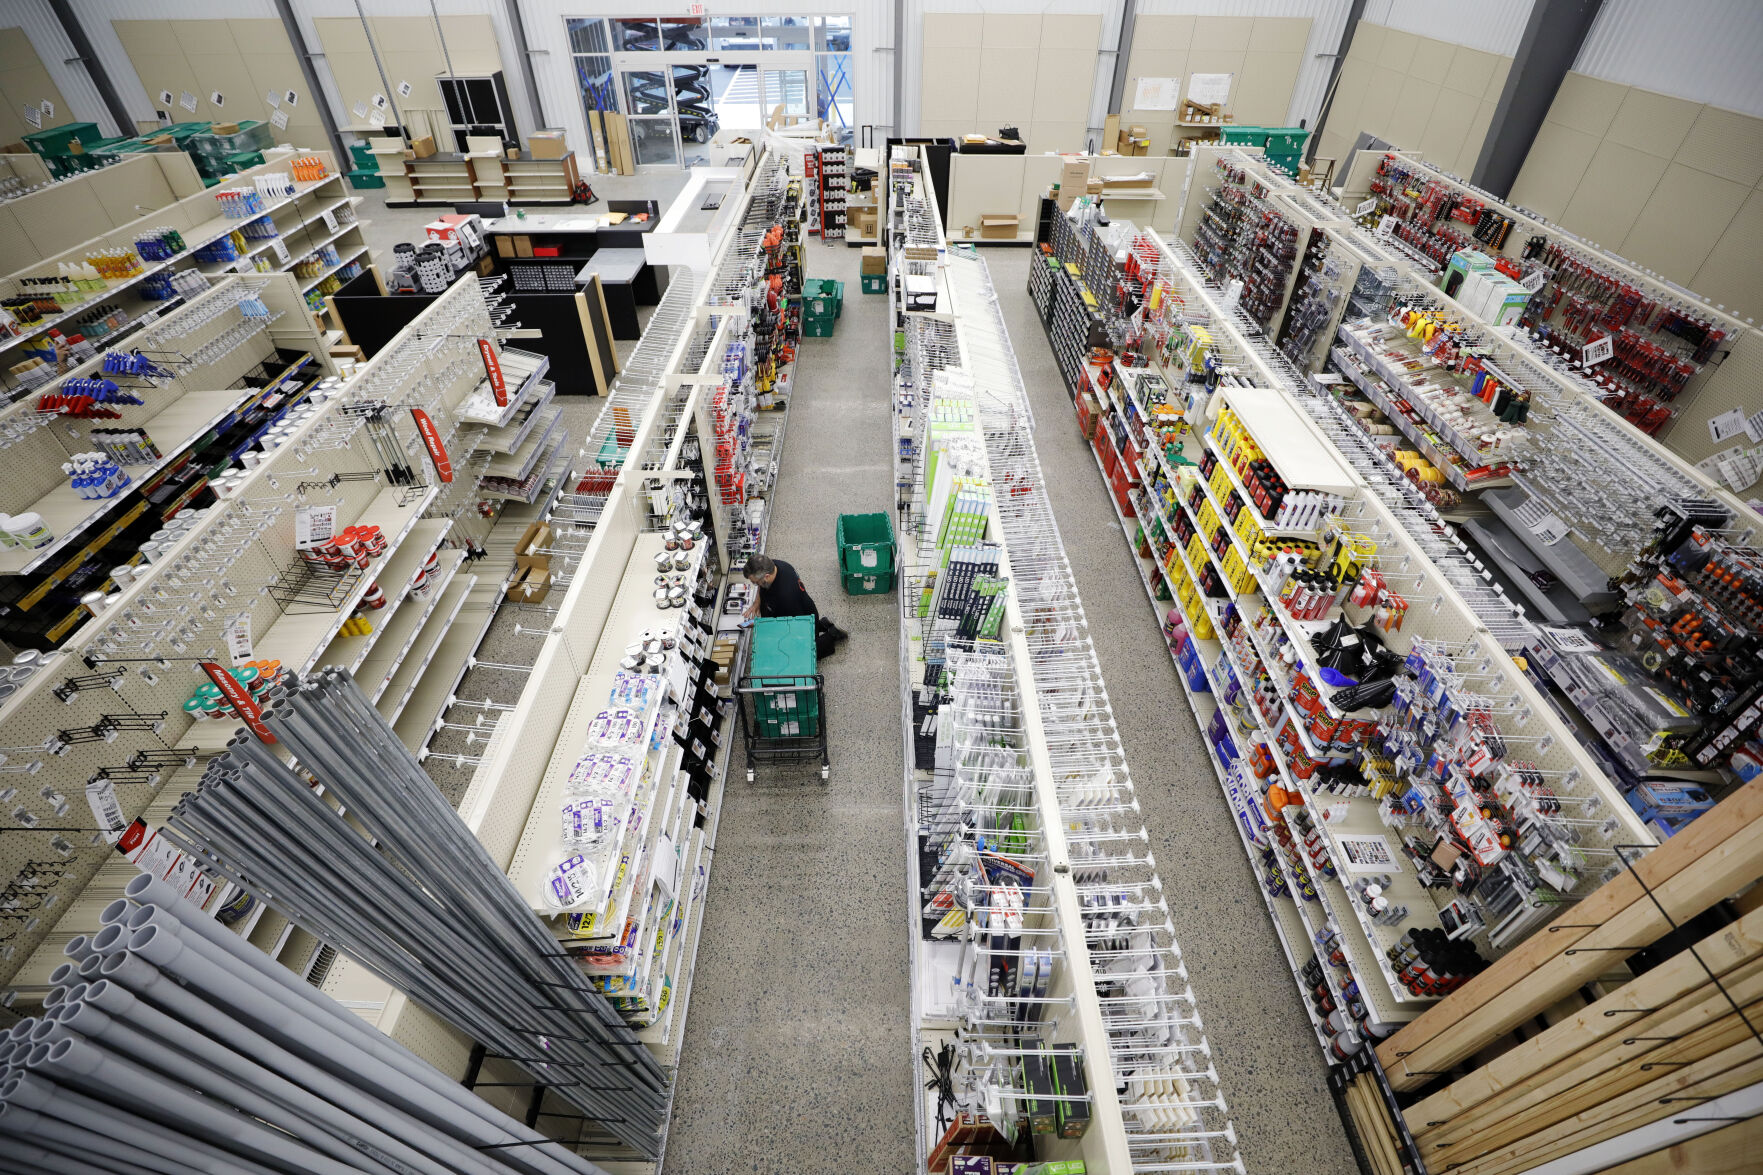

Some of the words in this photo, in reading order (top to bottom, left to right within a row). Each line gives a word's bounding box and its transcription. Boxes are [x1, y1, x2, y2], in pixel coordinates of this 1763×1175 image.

[691, 4, 703, 15] EXIT
[483, 344, 494, 366] Drywall
[491, 372, 500, 387] Tools
[420, 418, 432, 436] Wood
[428, 436, 441, 457] Repair
[213, 669, 240, 699] Masonry
[241, 706, 255, 719] Tile
[1301, 681, 1318, 698] SHOP
[1317, 711, 1335, 728] SHOP
[1297, 751, 1311, 768] SHOP
[581, 912, 595, 929] 12/2
[1067, 1162, 1083, 1170] LED
